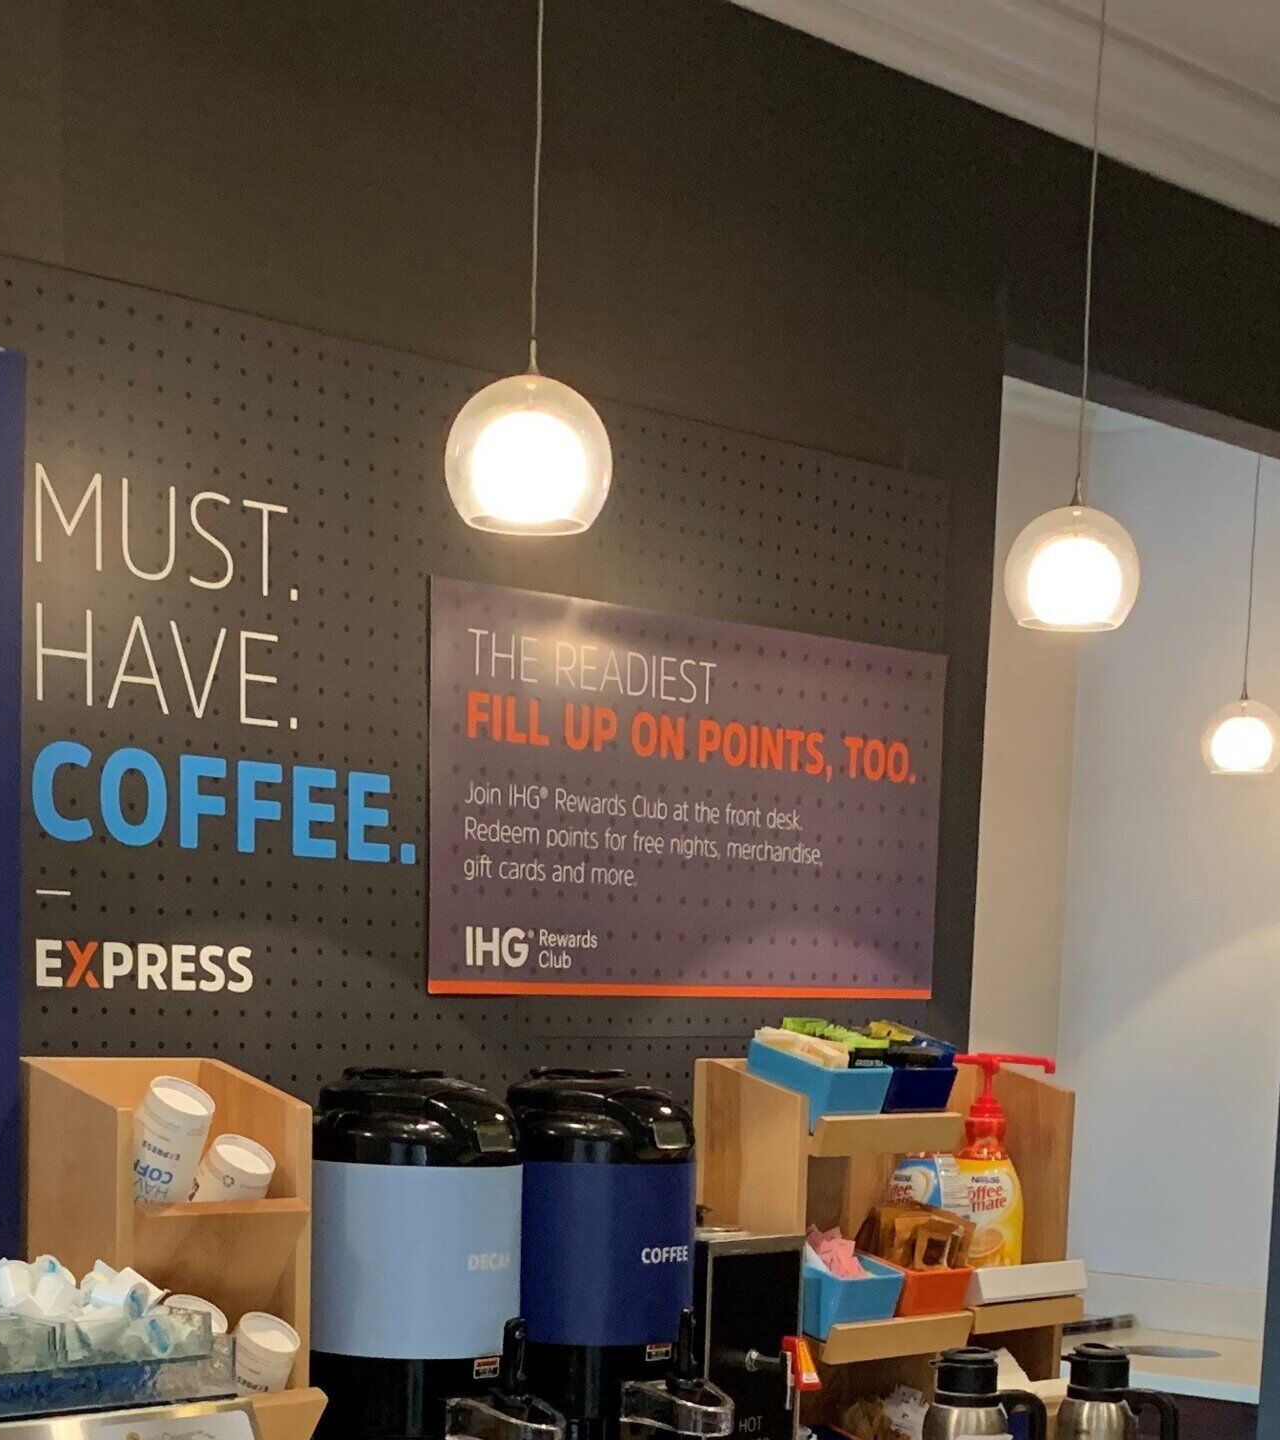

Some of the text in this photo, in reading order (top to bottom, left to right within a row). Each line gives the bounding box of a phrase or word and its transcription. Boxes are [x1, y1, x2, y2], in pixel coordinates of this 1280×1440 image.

[36, 462, 298, 602] MUST.
[36, 602, 298, 730] HAVE.
[467, 627, 718, 706] THE READIEST
[466, 692, 917, 784] FILL UP ON POINTS, TOO.
[31, 740, 416, 865] COFFEE.
[464, 782, 502, 806] Join
[554, 789, 627, 818] Rewards
[632, 795, 668, 821] Club
[672, 801, 689, 823] at
[694, 799, 721, 825] the
[725, 802, 762, 829] front
[766, 805, 804, 832] desk.
[464, 817, 823, 868] Redeem points for free nights, merchandise,
[463, 855, 637, 888] gift cards and more.
[538, 928, 599, 949] Rewards
[538, 950, 573, 969] Club
[35, 938, 253, 994] EXPRESS
[641, 1245, 689, 1264] COFFEE
[738, 1415, 763, 1433] HOT
